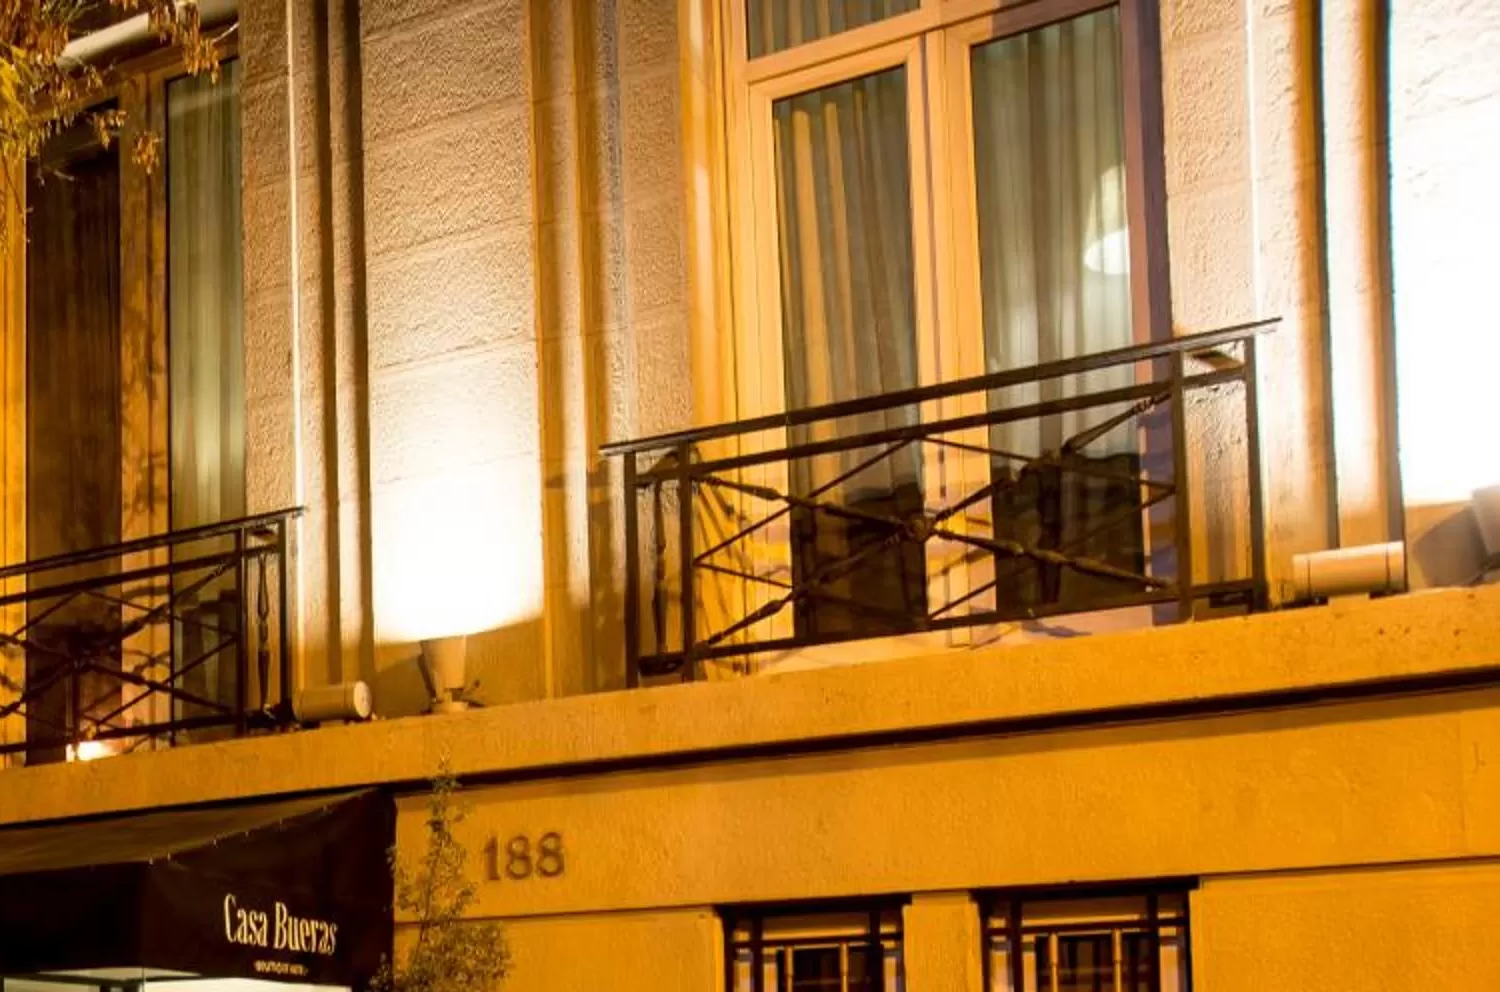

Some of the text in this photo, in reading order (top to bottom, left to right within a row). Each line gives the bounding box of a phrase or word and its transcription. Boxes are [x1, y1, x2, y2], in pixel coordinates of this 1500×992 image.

[484, 832, 564, 880] 188
[224, 892, 338, 955] Casa Bueras
